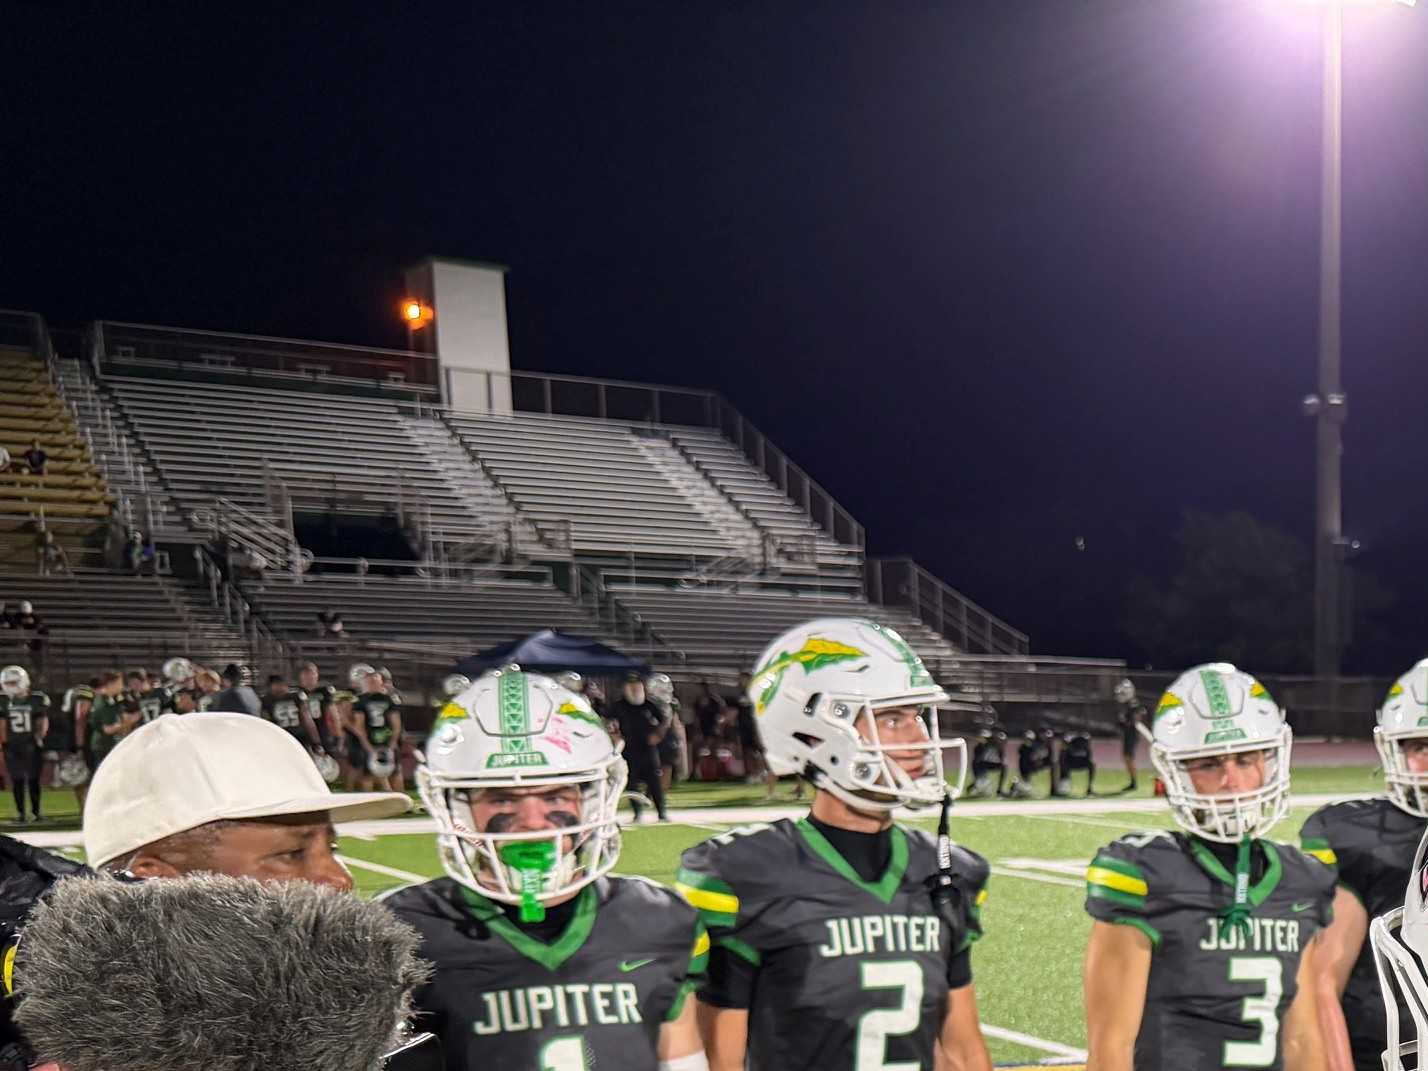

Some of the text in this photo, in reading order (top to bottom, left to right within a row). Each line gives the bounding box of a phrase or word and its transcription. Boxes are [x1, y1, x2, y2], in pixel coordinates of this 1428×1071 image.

[9, 711, 32, 733] 21
[818, 914, 942, 958] JUPITER
[473, 982, 643, 1036] JUPITER
[1221, 956, 1285, 1067] 3
